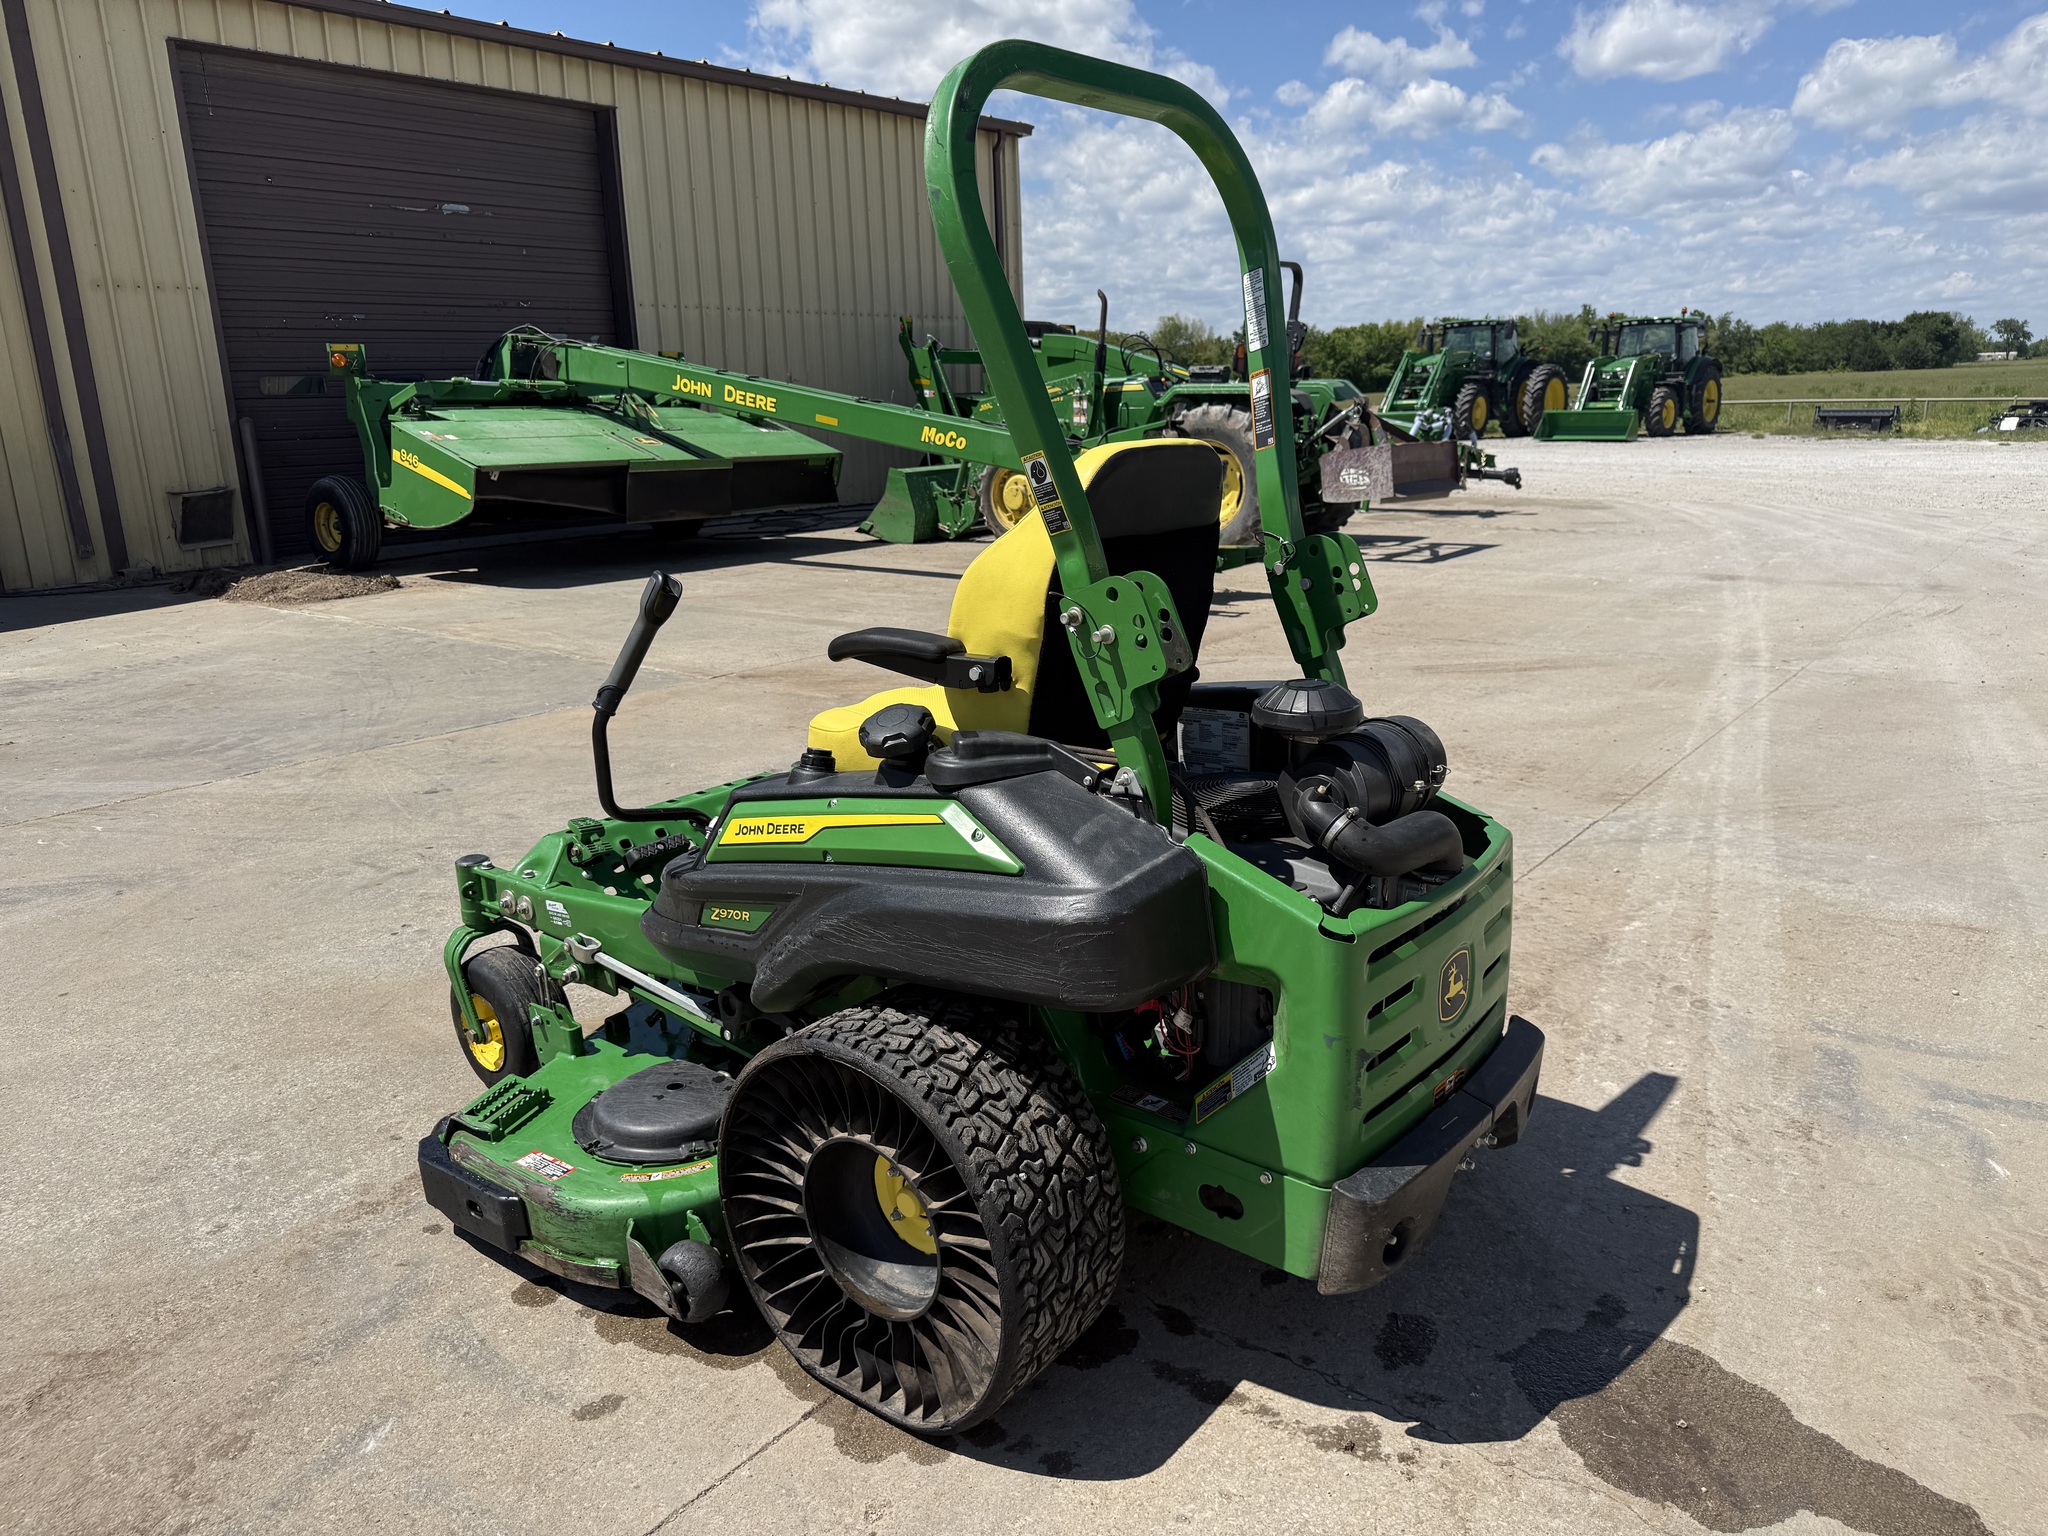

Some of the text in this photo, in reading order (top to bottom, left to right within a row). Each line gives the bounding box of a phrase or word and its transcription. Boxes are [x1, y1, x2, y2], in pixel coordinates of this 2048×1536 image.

[672, 374, 777, 413] JOHN DEERE
[921, 426, 967, 450] MoCo
[400, 449, 419, 468] 946
[735, 823, 805, 835] JOHN DEERE
[711, 907, 750, 921] Z970R
